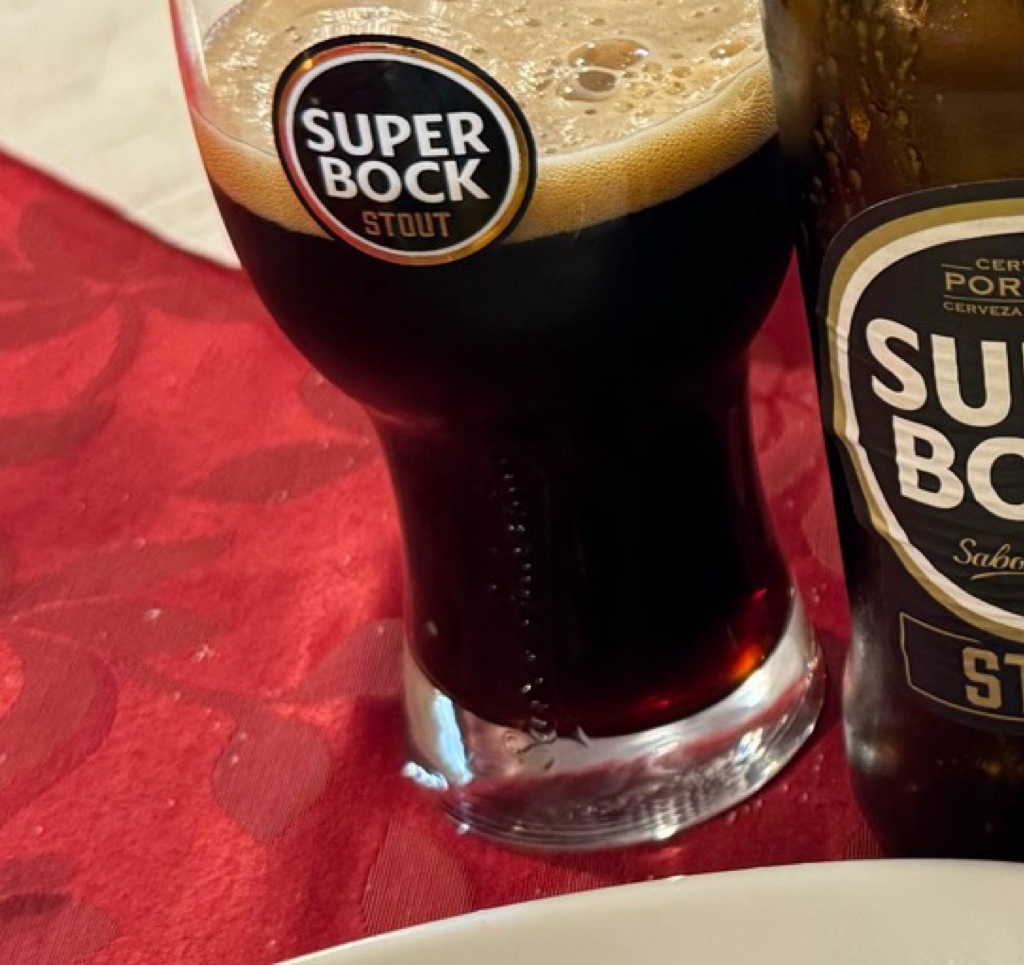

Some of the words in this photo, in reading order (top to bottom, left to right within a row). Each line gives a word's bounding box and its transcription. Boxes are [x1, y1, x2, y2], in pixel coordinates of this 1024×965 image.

[302, 107, 491, 157] SUPER
[318, 155, 492, 204] BOCK
[362, 210, 451, 237] STOUT
[943, 301, 1023, 317] CERVEZA
